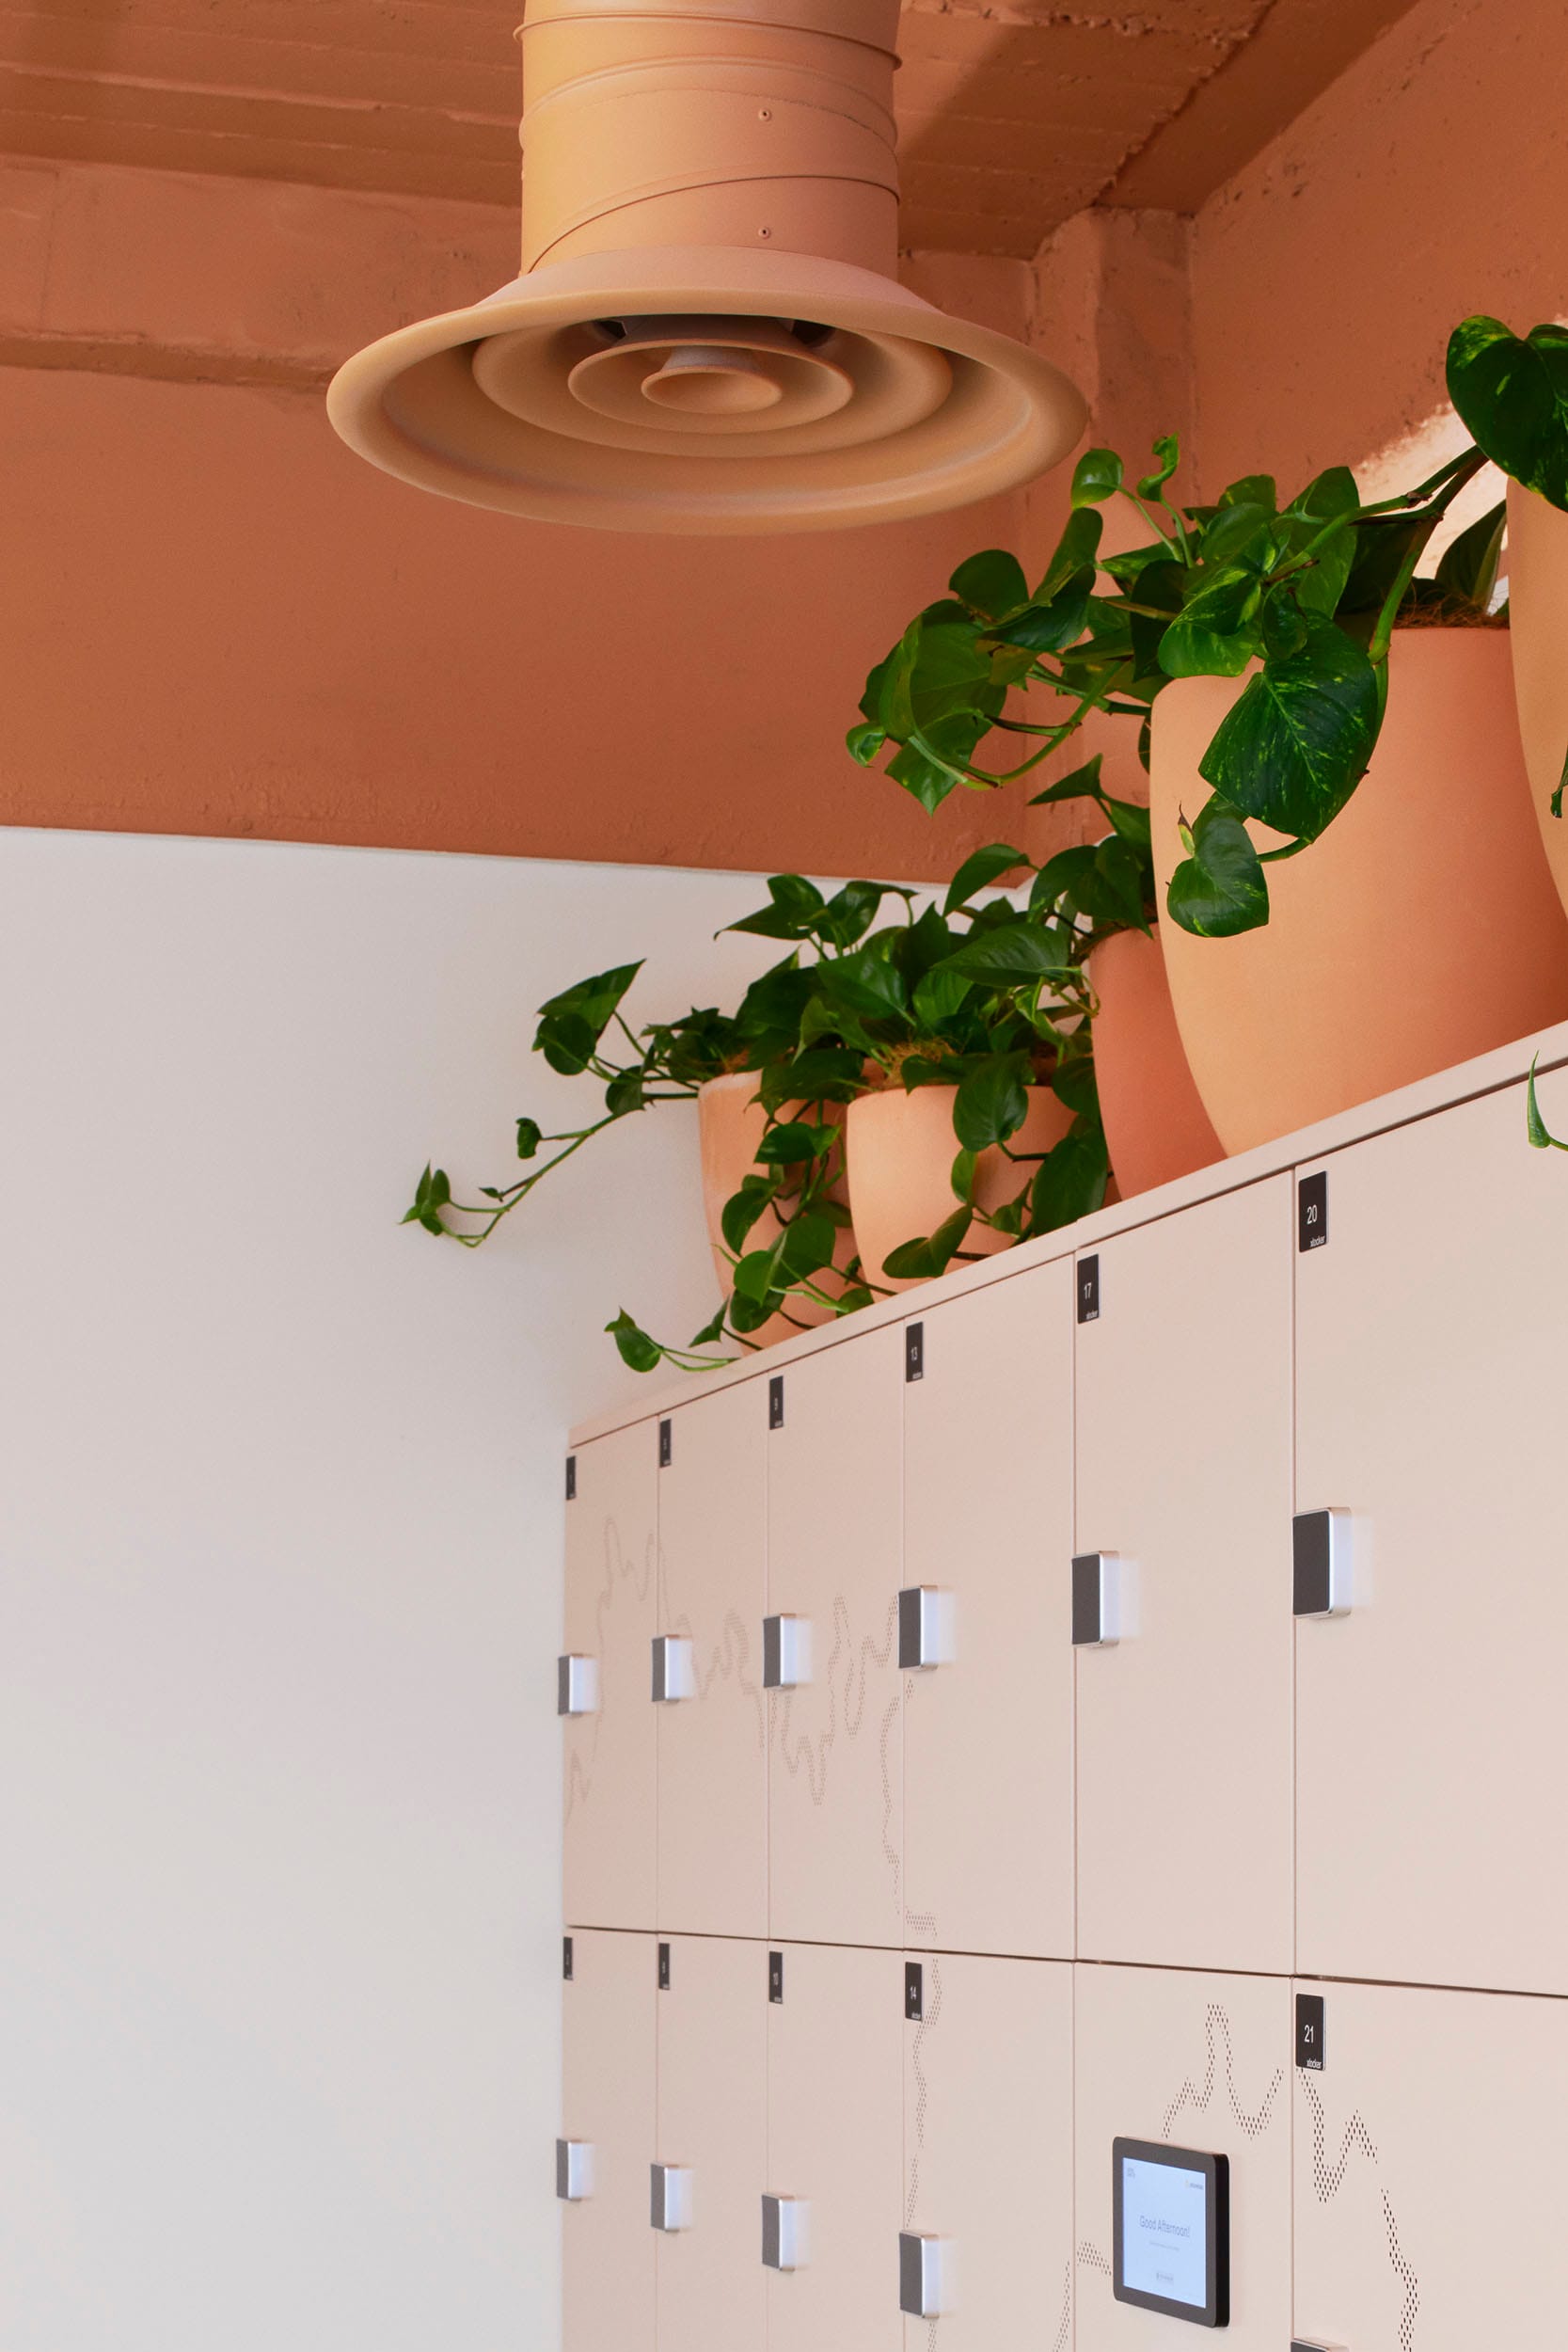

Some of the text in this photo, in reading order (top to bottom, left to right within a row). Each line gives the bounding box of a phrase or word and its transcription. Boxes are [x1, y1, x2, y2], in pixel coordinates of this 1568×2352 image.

[1307, 1204, 1318, 1225] 20
[1084, 1281, 1092, 1300] 17
[1304, 2024, 1314, 2043] 21
[1139, 2215, 1190, 2239] Good Afternoon!
